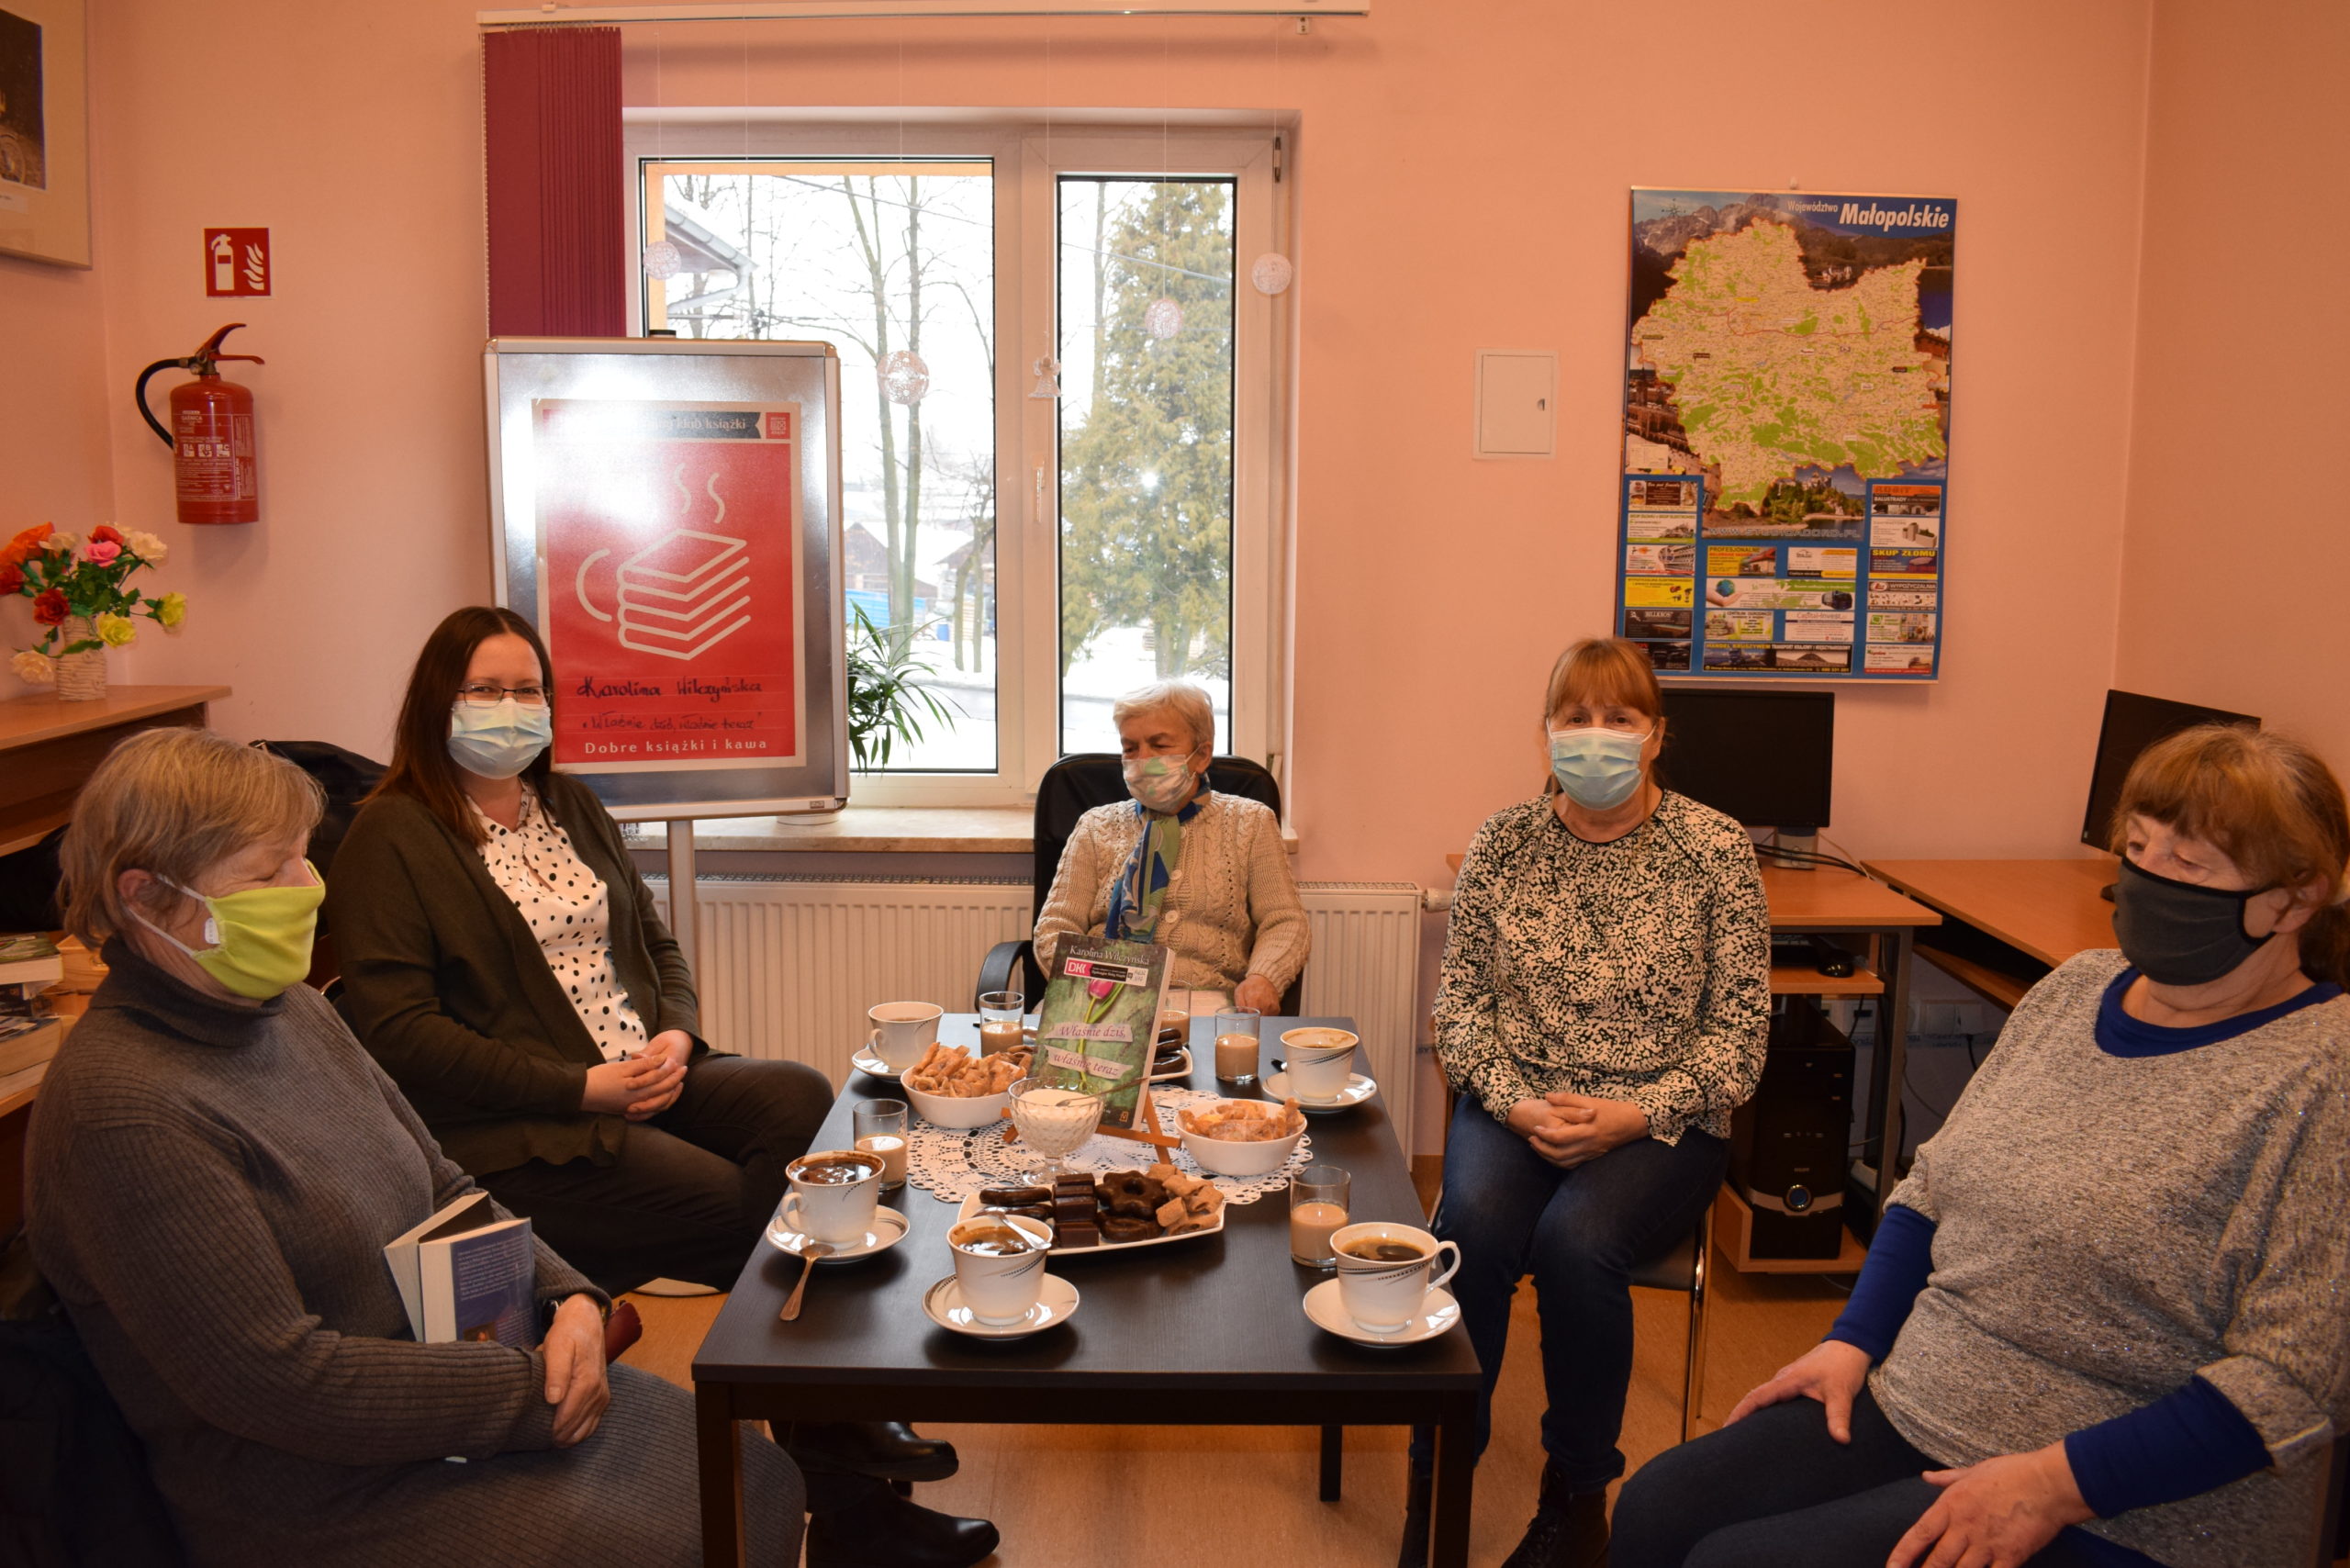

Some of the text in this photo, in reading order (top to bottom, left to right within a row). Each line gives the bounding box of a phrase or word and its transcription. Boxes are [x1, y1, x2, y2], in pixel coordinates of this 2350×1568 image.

[1787, 201, 1950, 232] Województwo Małopolskie
[705, 418, 746, 432] książki
[576, 676, 662, 698] Karolina
[585, 742, 638, 754] Dobre
[645, 740, 705, 754] książki
[724, 738, 767, 750] kawa
[1069, 945, 1150, 966] Karolina Wilczyńska
[1060, 1025, 1125, 1038] Właśnie dziś,
[1053, 1053, 1120, 1075] właśnie teraz
